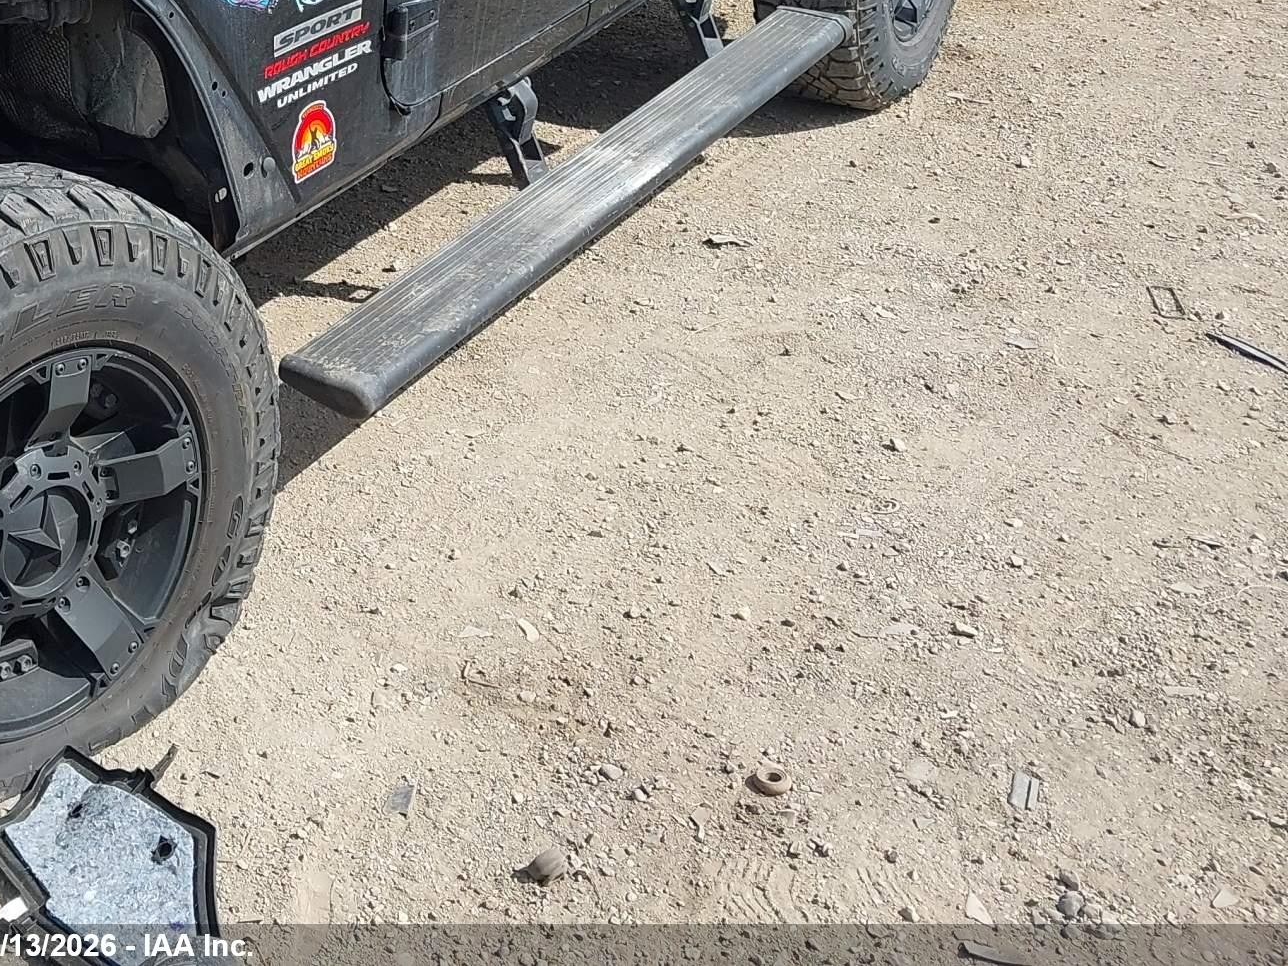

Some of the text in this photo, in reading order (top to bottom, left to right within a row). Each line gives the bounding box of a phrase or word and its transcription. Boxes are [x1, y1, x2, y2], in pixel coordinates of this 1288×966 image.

[264, 21, 371, 80] ROUGH COUNTRY
[279, 7, 358, 47] SPORT
[257, 40, 373, 103] WRANGLER
[277, 62, 359, 109] UNLIMITED
